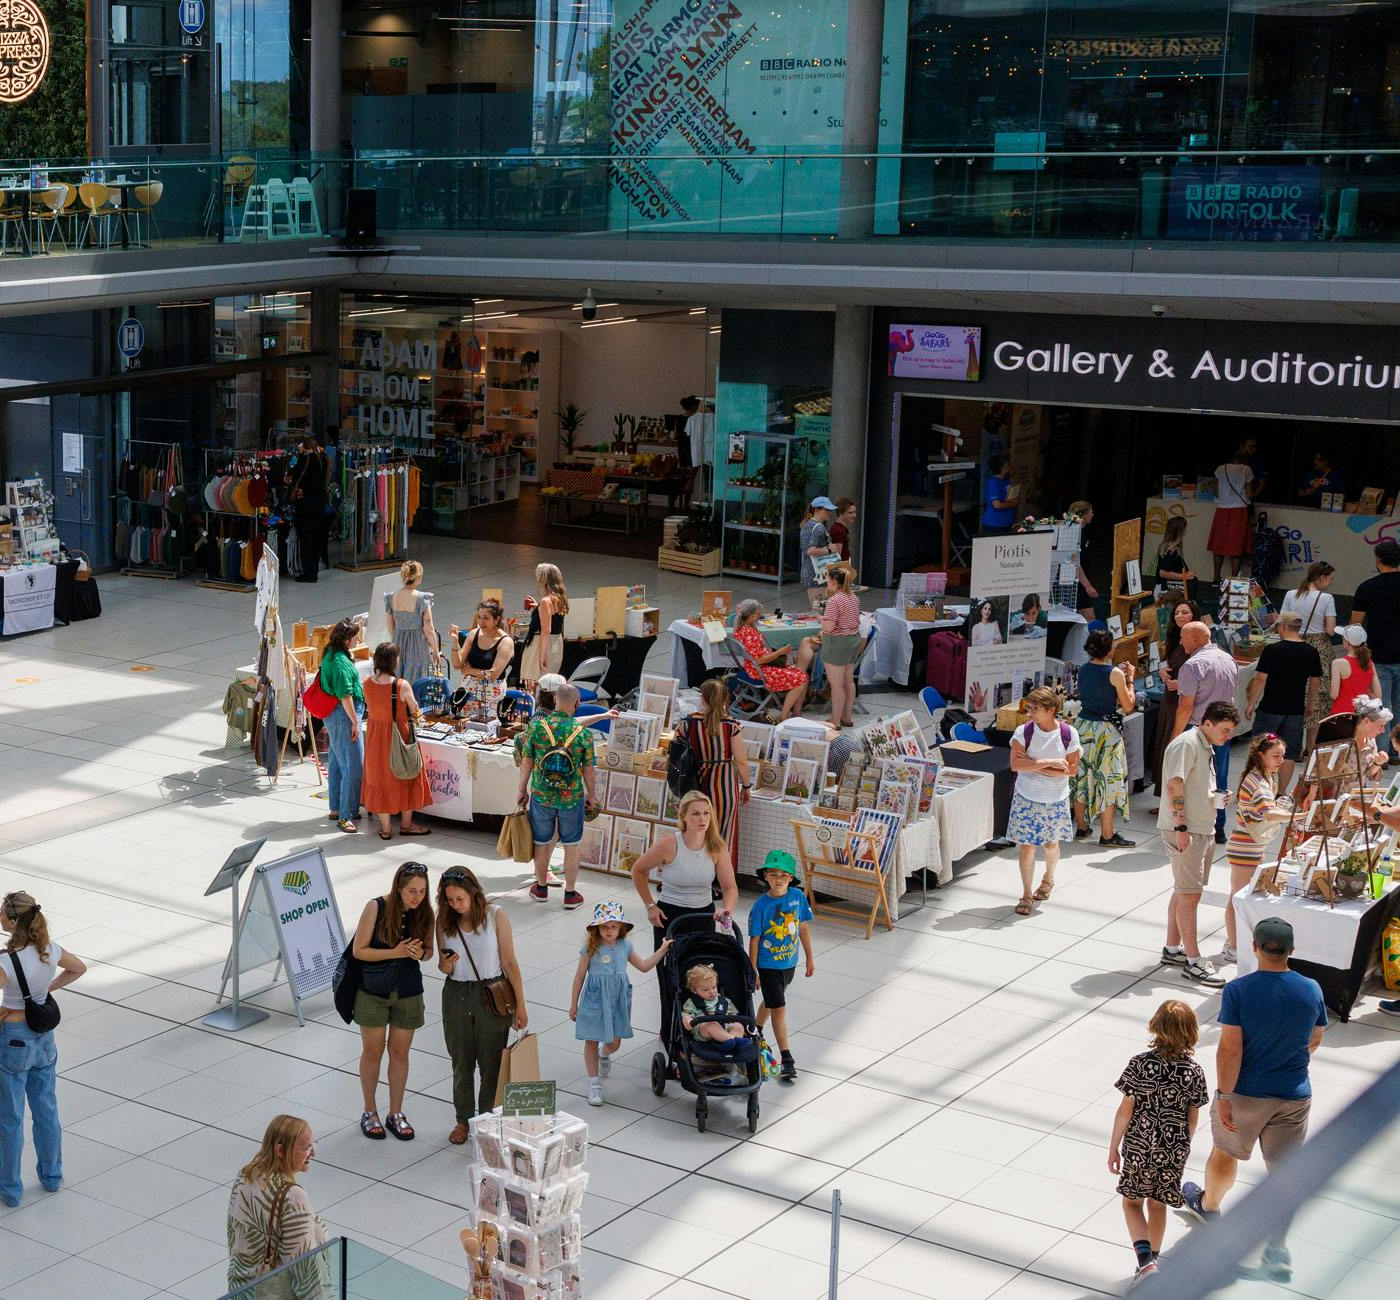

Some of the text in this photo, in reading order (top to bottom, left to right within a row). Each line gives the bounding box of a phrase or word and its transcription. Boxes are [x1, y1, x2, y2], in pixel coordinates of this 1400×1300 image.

[182, 35, 193, 46] Lift
[612, 21, 655, 70] DISS
[696, 31, 738, 77] STALHAM
[702, 22, 759, 85] HETHERSETT
[610, 57, 644, 101] REAT
[614, 0, 743, 146] KING'S LYNN
[760, 58, 795, 71] BBC
[797, 58, 832, 69] RADIO
[624, 88, 686, 155] BLAKENEY
[684, 74, 757, 155] DEREHAM
[684, 97, 733, 154] HEACHAM
[676, 123, 712, 166] MARHA
[639, 164, 691, 221] HAPPISBURGH
[1186, 184, 1302, 200] BBC RADIO
[1186, 202, 1298, 220] NORFOLK
[359, 337, 437, 370] ADAM
[993, 341, 1133, 382] Gallery
[1148, 349, 1176, 378] &
[358, 373, 420, 401] FROM
[358, 403, 436, 440] HOME
[994, 543, 1032, 560] Piotis
[1000, 561, 1025, 569] Naturals
[430, 780, 461, 800] hadow
[280, 897, 330, 925] SHOP OPEN
